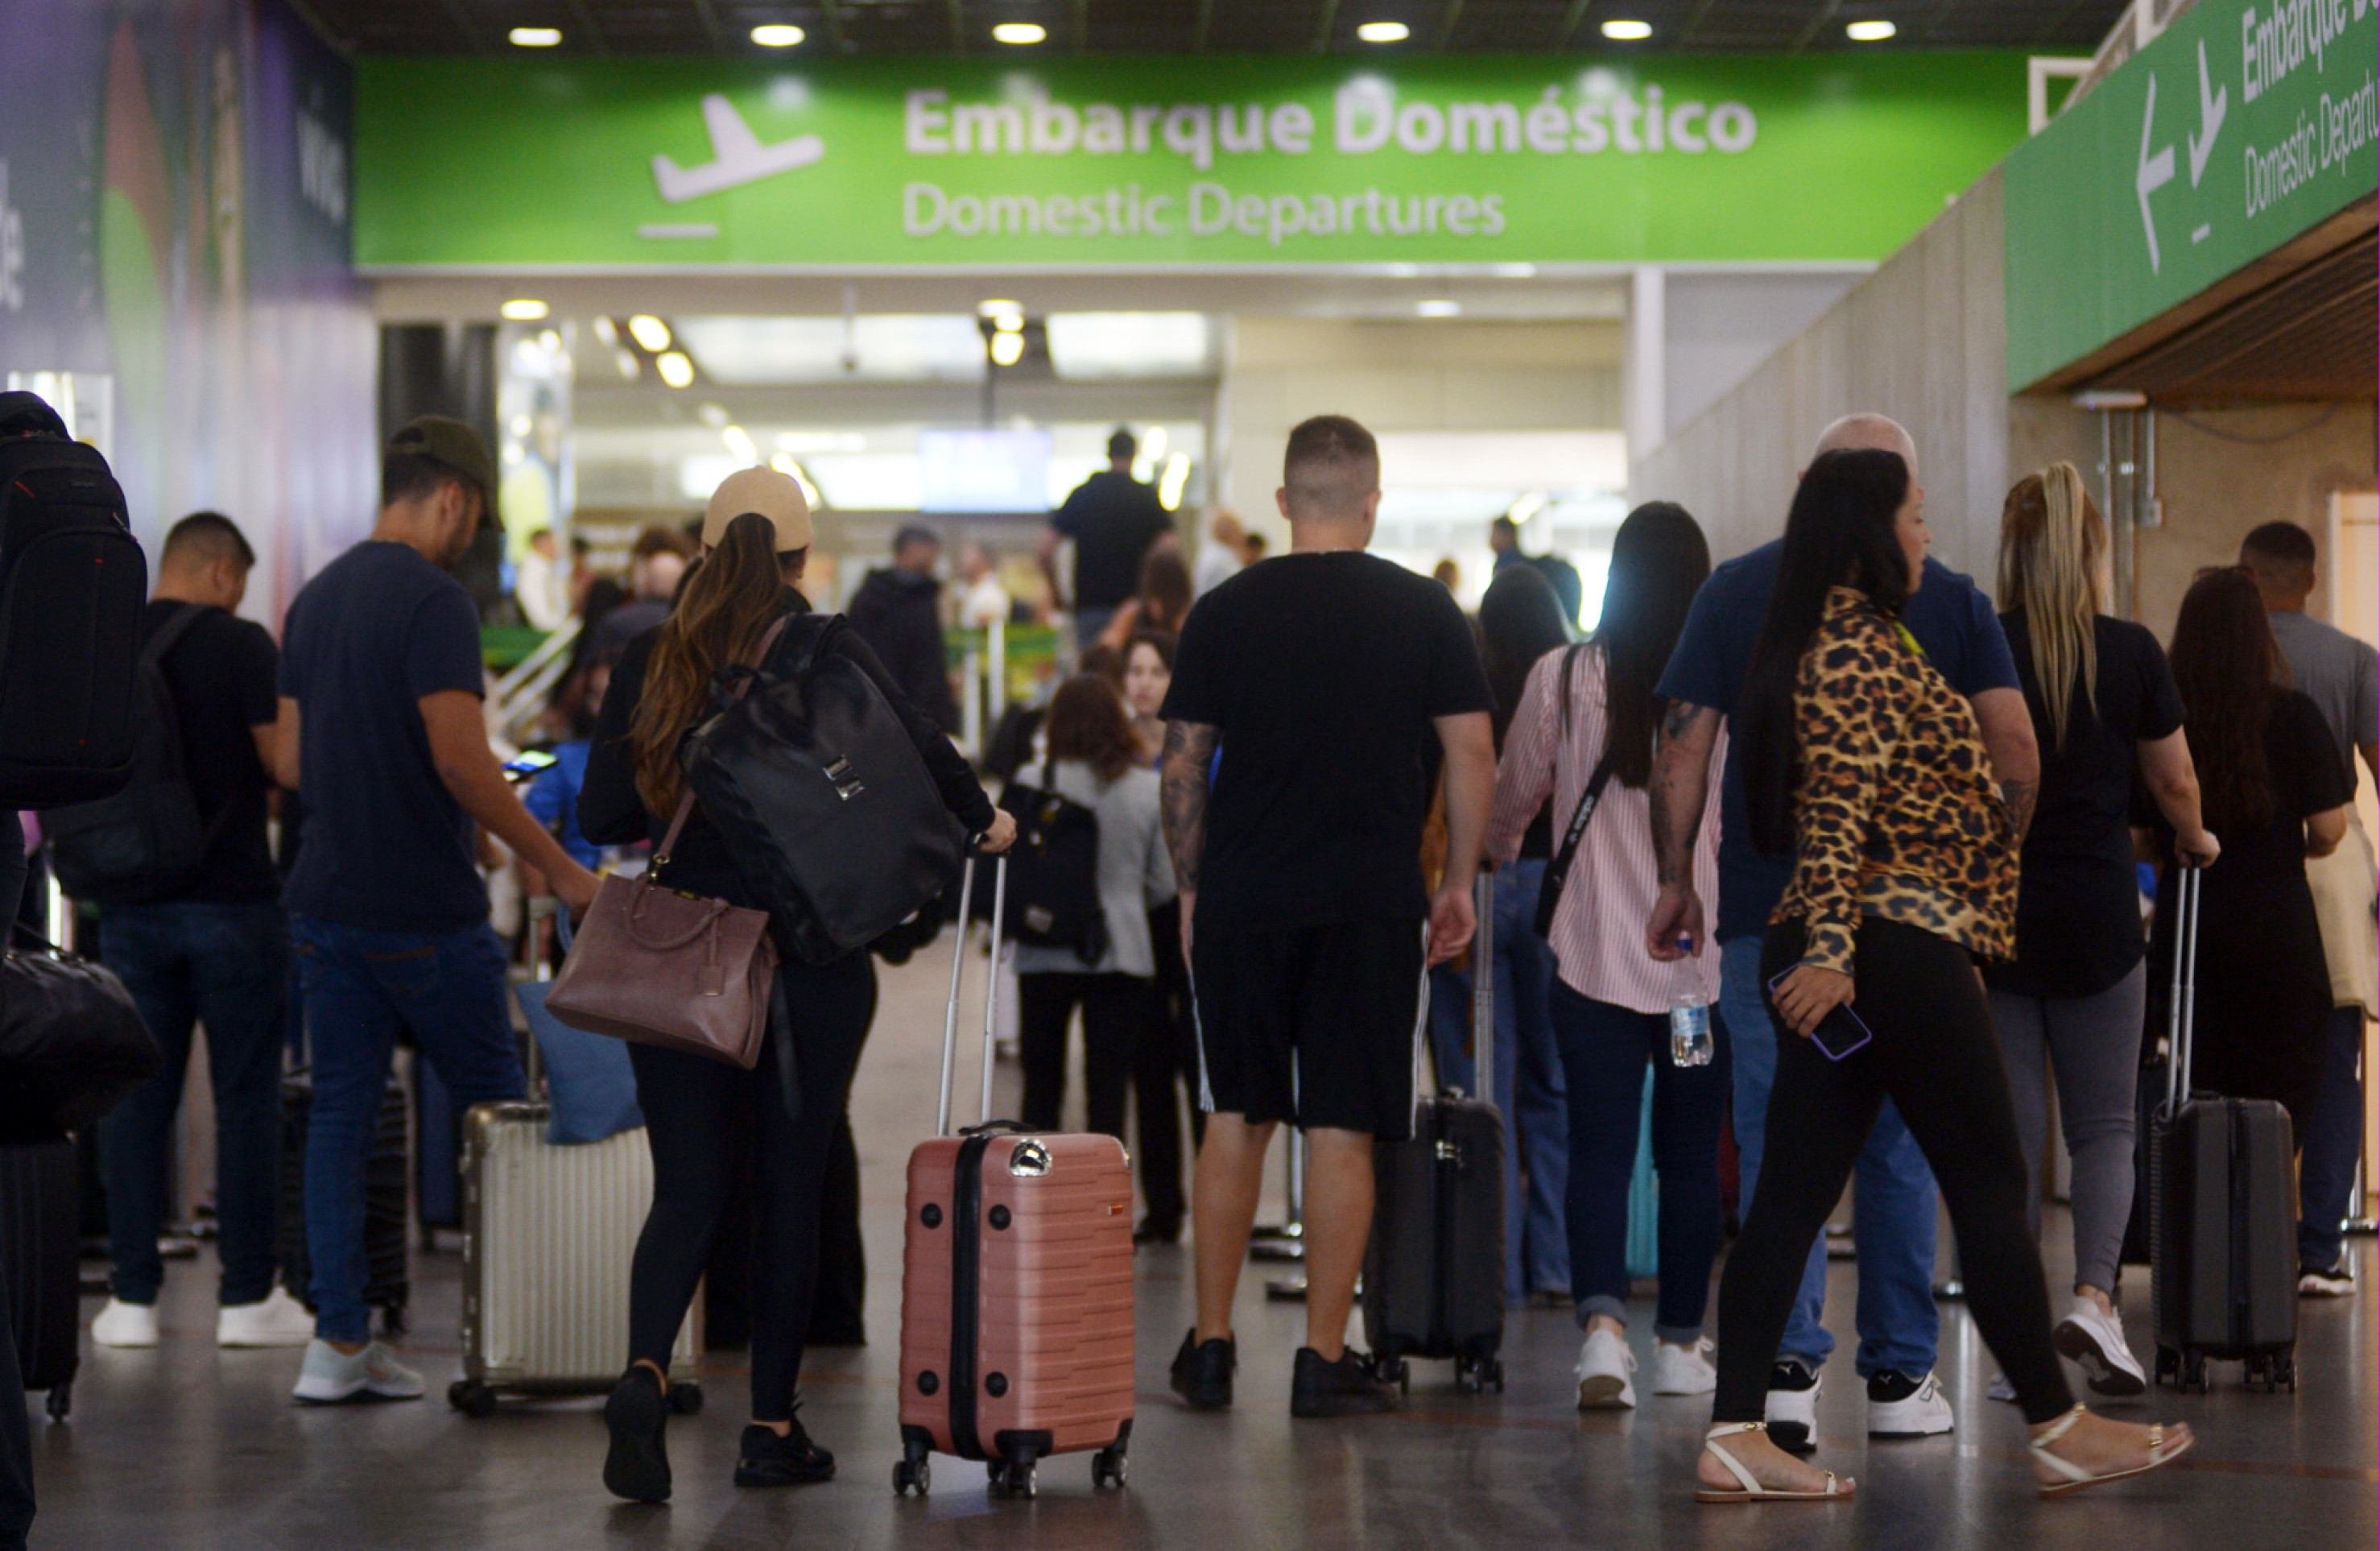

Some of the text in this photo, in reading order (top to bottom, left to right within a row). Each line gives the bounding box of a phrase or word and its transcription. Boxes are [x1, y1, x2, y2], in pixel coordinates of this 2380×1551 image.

[903, 82, 1758, 170] Embarque Doméstico
[2244, 106, 2317, 219] Domestic
[903, 181, 1506, 246] Domestic Departures
